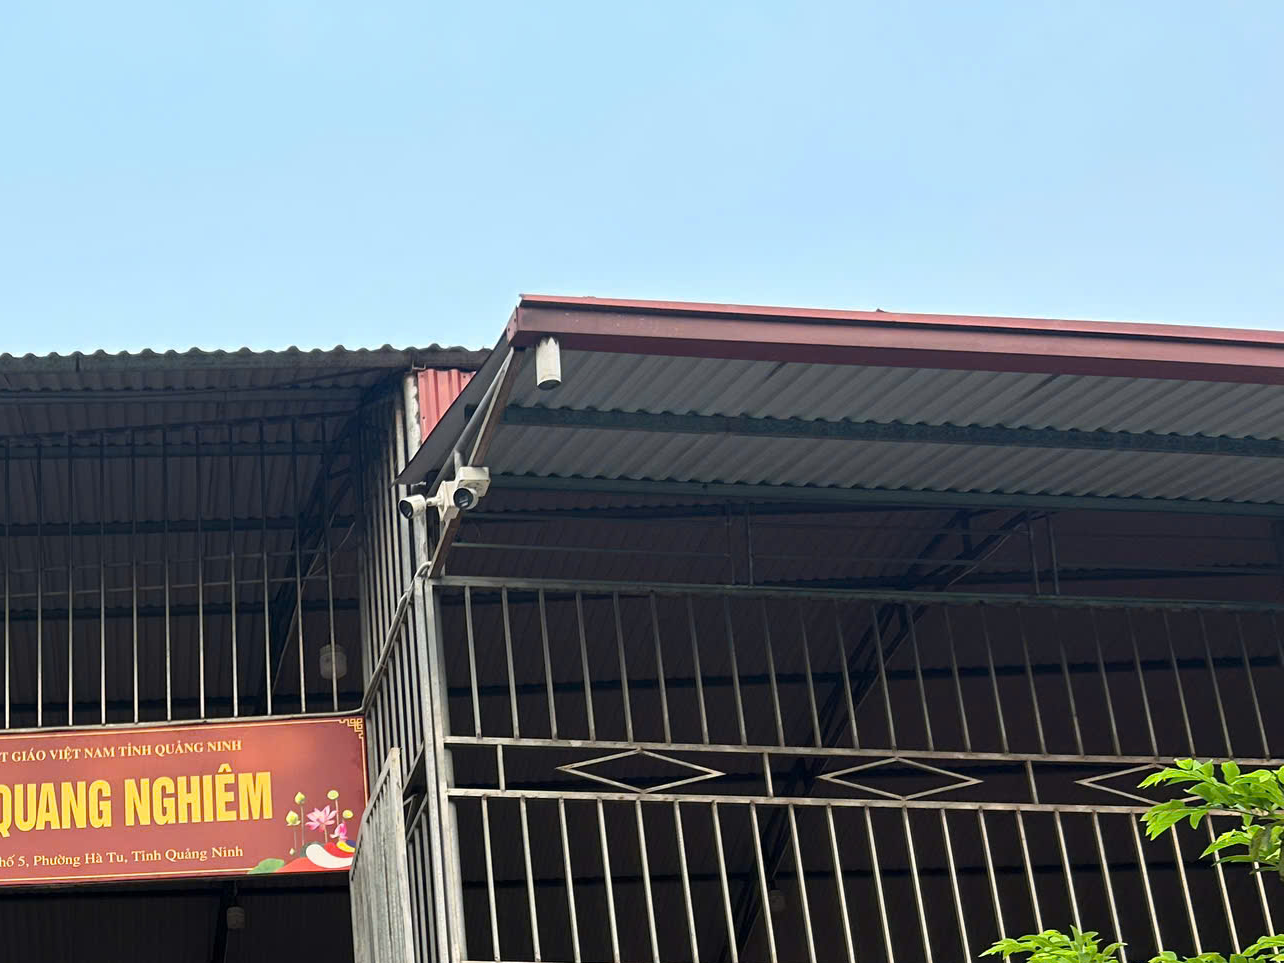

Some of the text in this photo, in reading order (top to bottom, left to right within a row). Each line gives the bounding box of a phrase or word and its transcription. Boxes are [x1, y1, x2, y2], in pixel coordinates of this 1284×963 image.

[11, 748, 46, 762] GIÁO
[49, 746, 81, 762] VIỆT
[84, 746, 115, 759] NAM
[118, 742, 152, 757] TỈNH
[155, 740, 204, 757] QUẢNG
[206, 740, 242, 752] NINH
[124, 763, 273, 826] NGHIÊM
[18, 856, 29, 868] 5,
[33, 854, 81, 868] Phường
[85, 852, 103, 864] Hà
[106, 852, 128, 864] Tu,
[132, 849, 161, 862] Tỉnh
[165, 848, 207, 861] Quảng
[211, 846, 243, 858] Ninh
